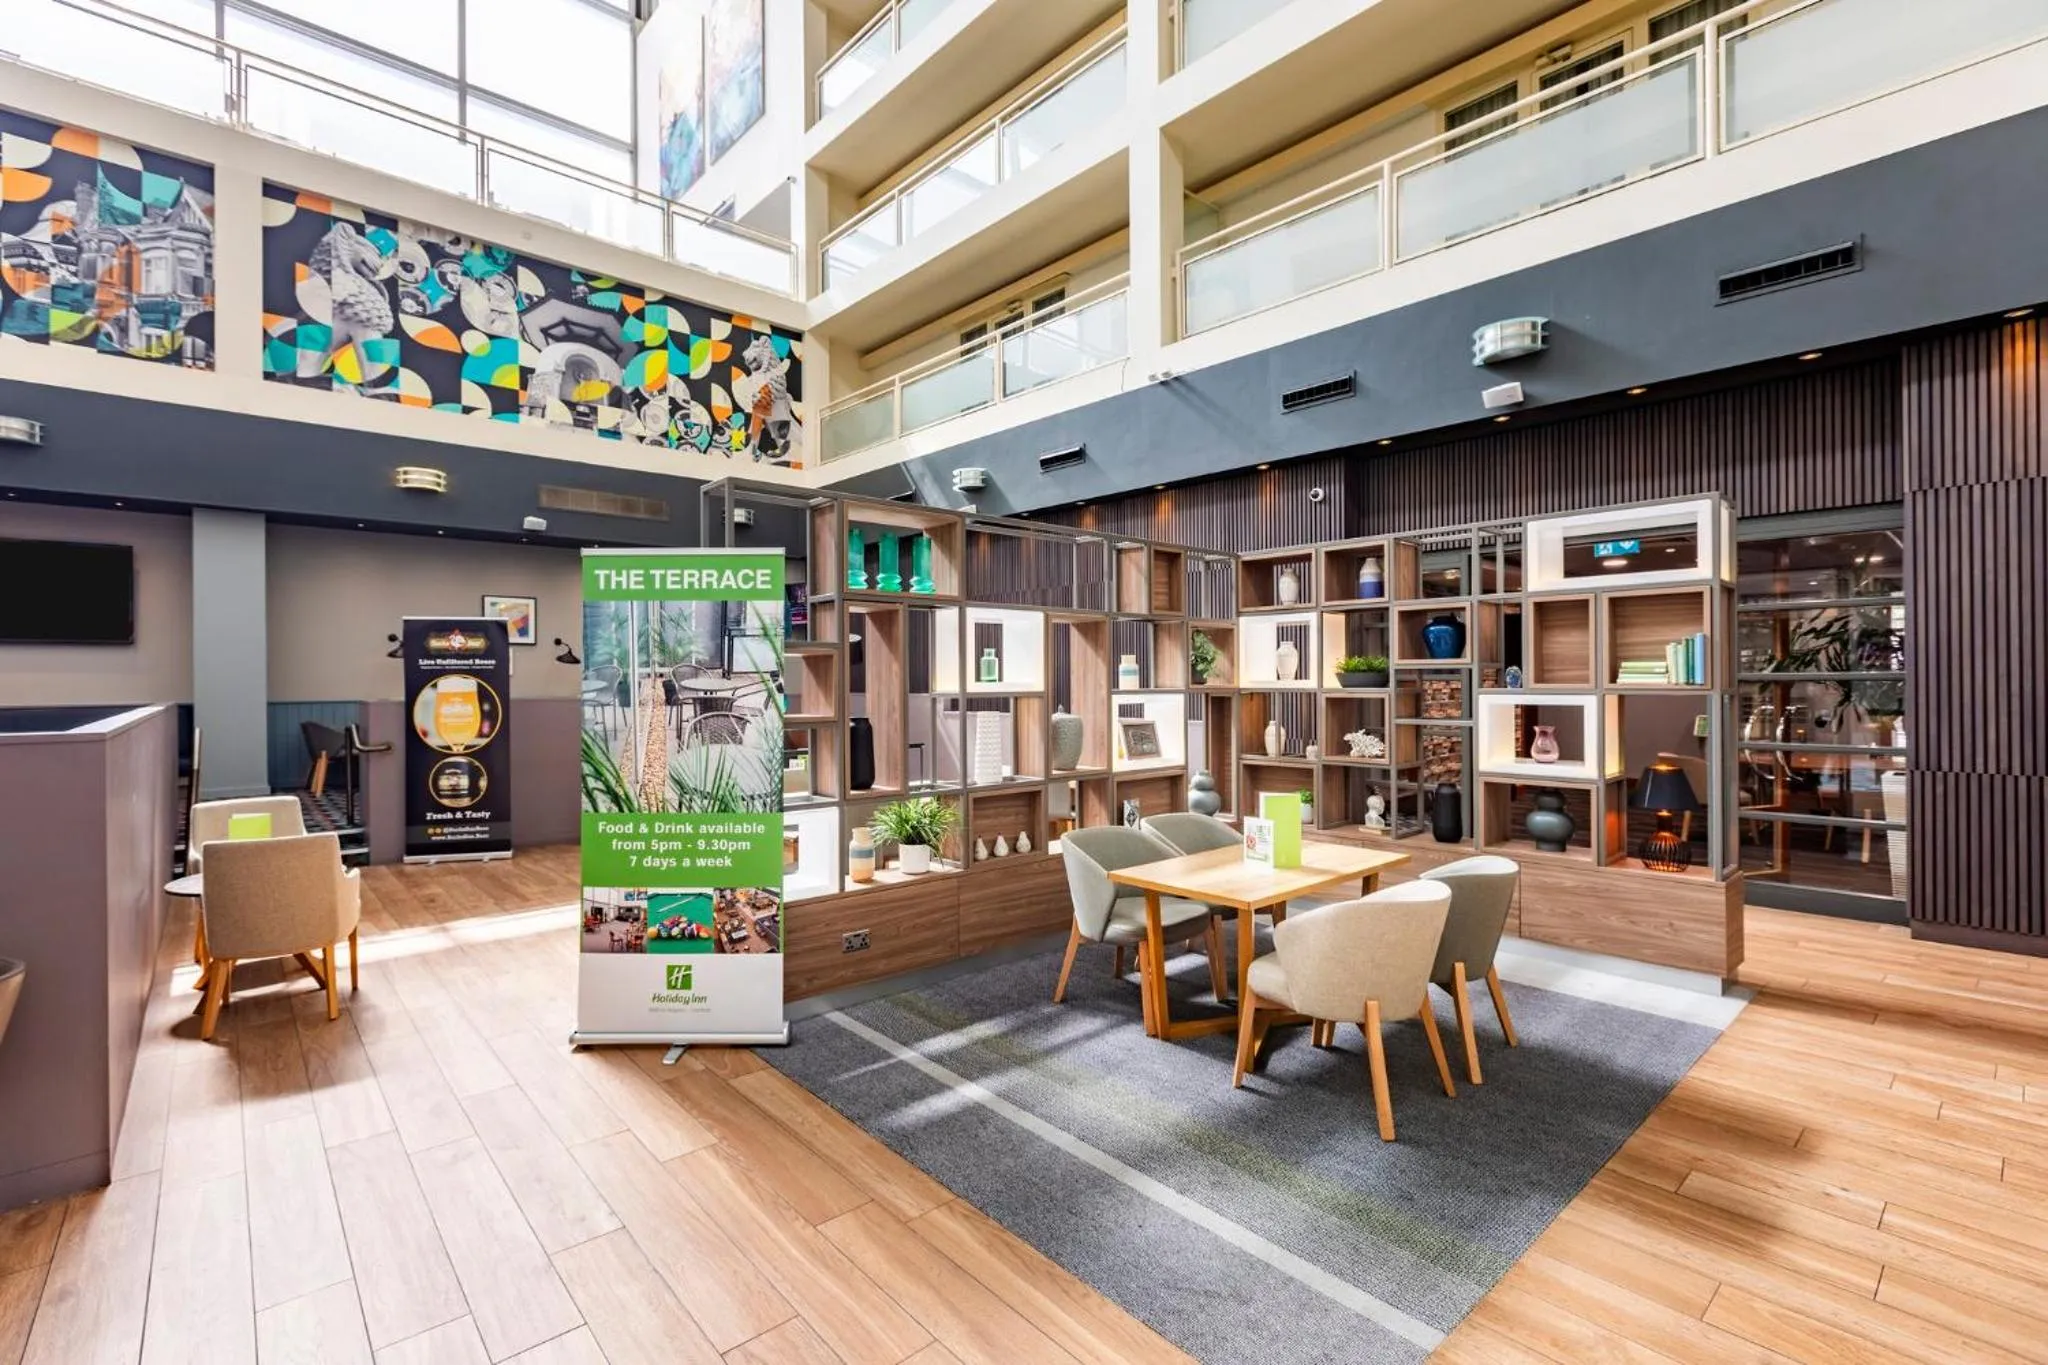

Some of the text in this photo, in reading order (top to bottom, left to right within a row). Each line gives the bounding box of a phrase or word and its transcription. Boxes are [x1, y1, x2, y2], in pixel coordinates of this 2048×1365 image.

[594, 568, 773, 590] THE TERRACE
[425, 810, 491, 821] Fresh & Tasty
[598, 821, 766, 834] Food & Drink available
[611, 838, 646, 851] from
[650, 839, 682, 853] 5pm
[696, 838, 751, 853] 9.30pm
[629, 855, 733, 870] 7 days a week
[652, 992, 707, 1005] Holiday Inn
